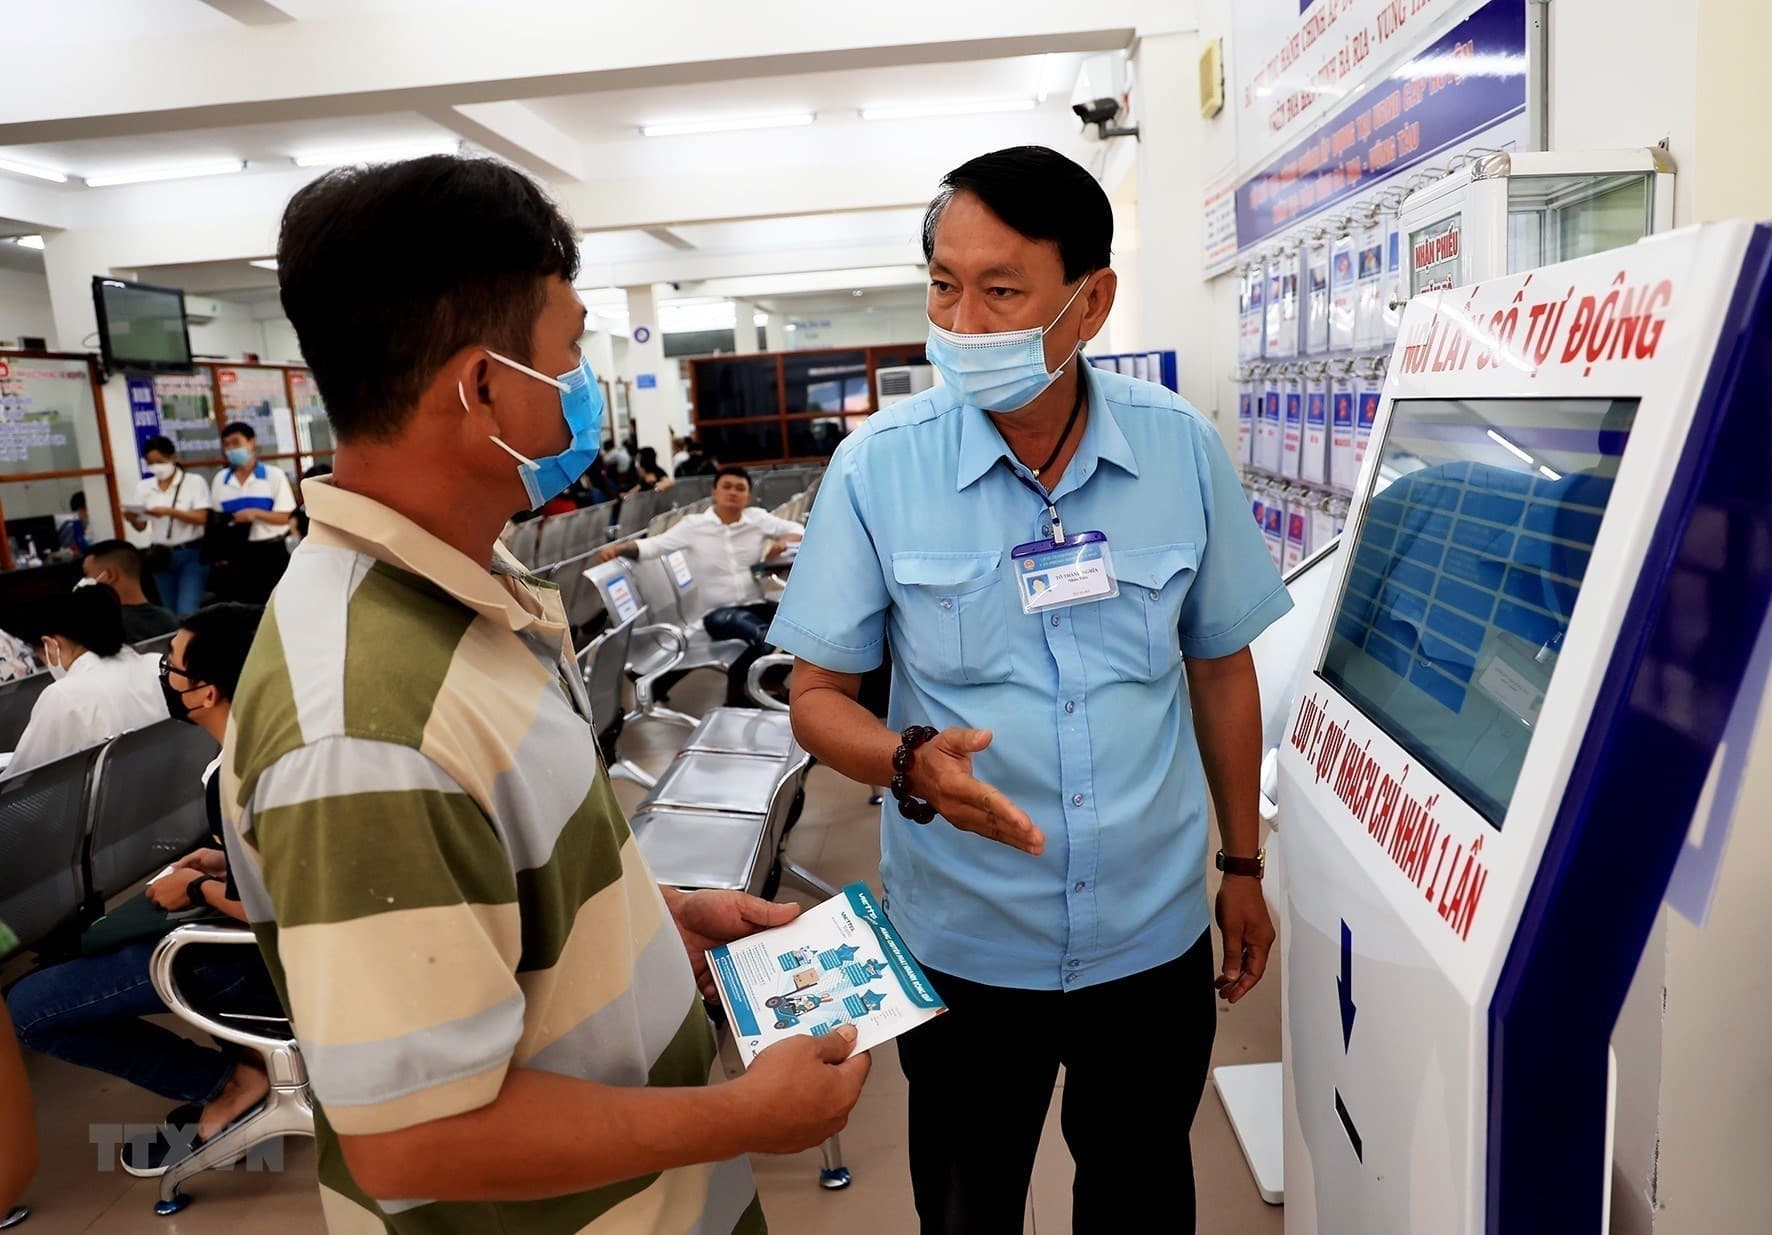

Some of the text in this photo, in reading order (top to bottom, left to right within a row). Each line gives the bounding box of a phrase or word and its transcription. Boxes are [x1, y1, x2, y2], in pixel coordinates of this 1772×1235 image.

[1415, 225, 1458, 270] NHẬN PHIẾU
[1477, 274, 1533, 370] SỐ
[1521, 286, 1576, 378] TỰ
[1561, 271, 1673, 377] ĐỘNG
[1291, 692, 1488, 942] LƯU Ý: QUÝ KHÁCH CHỈ NHẤN 1 LẦN
